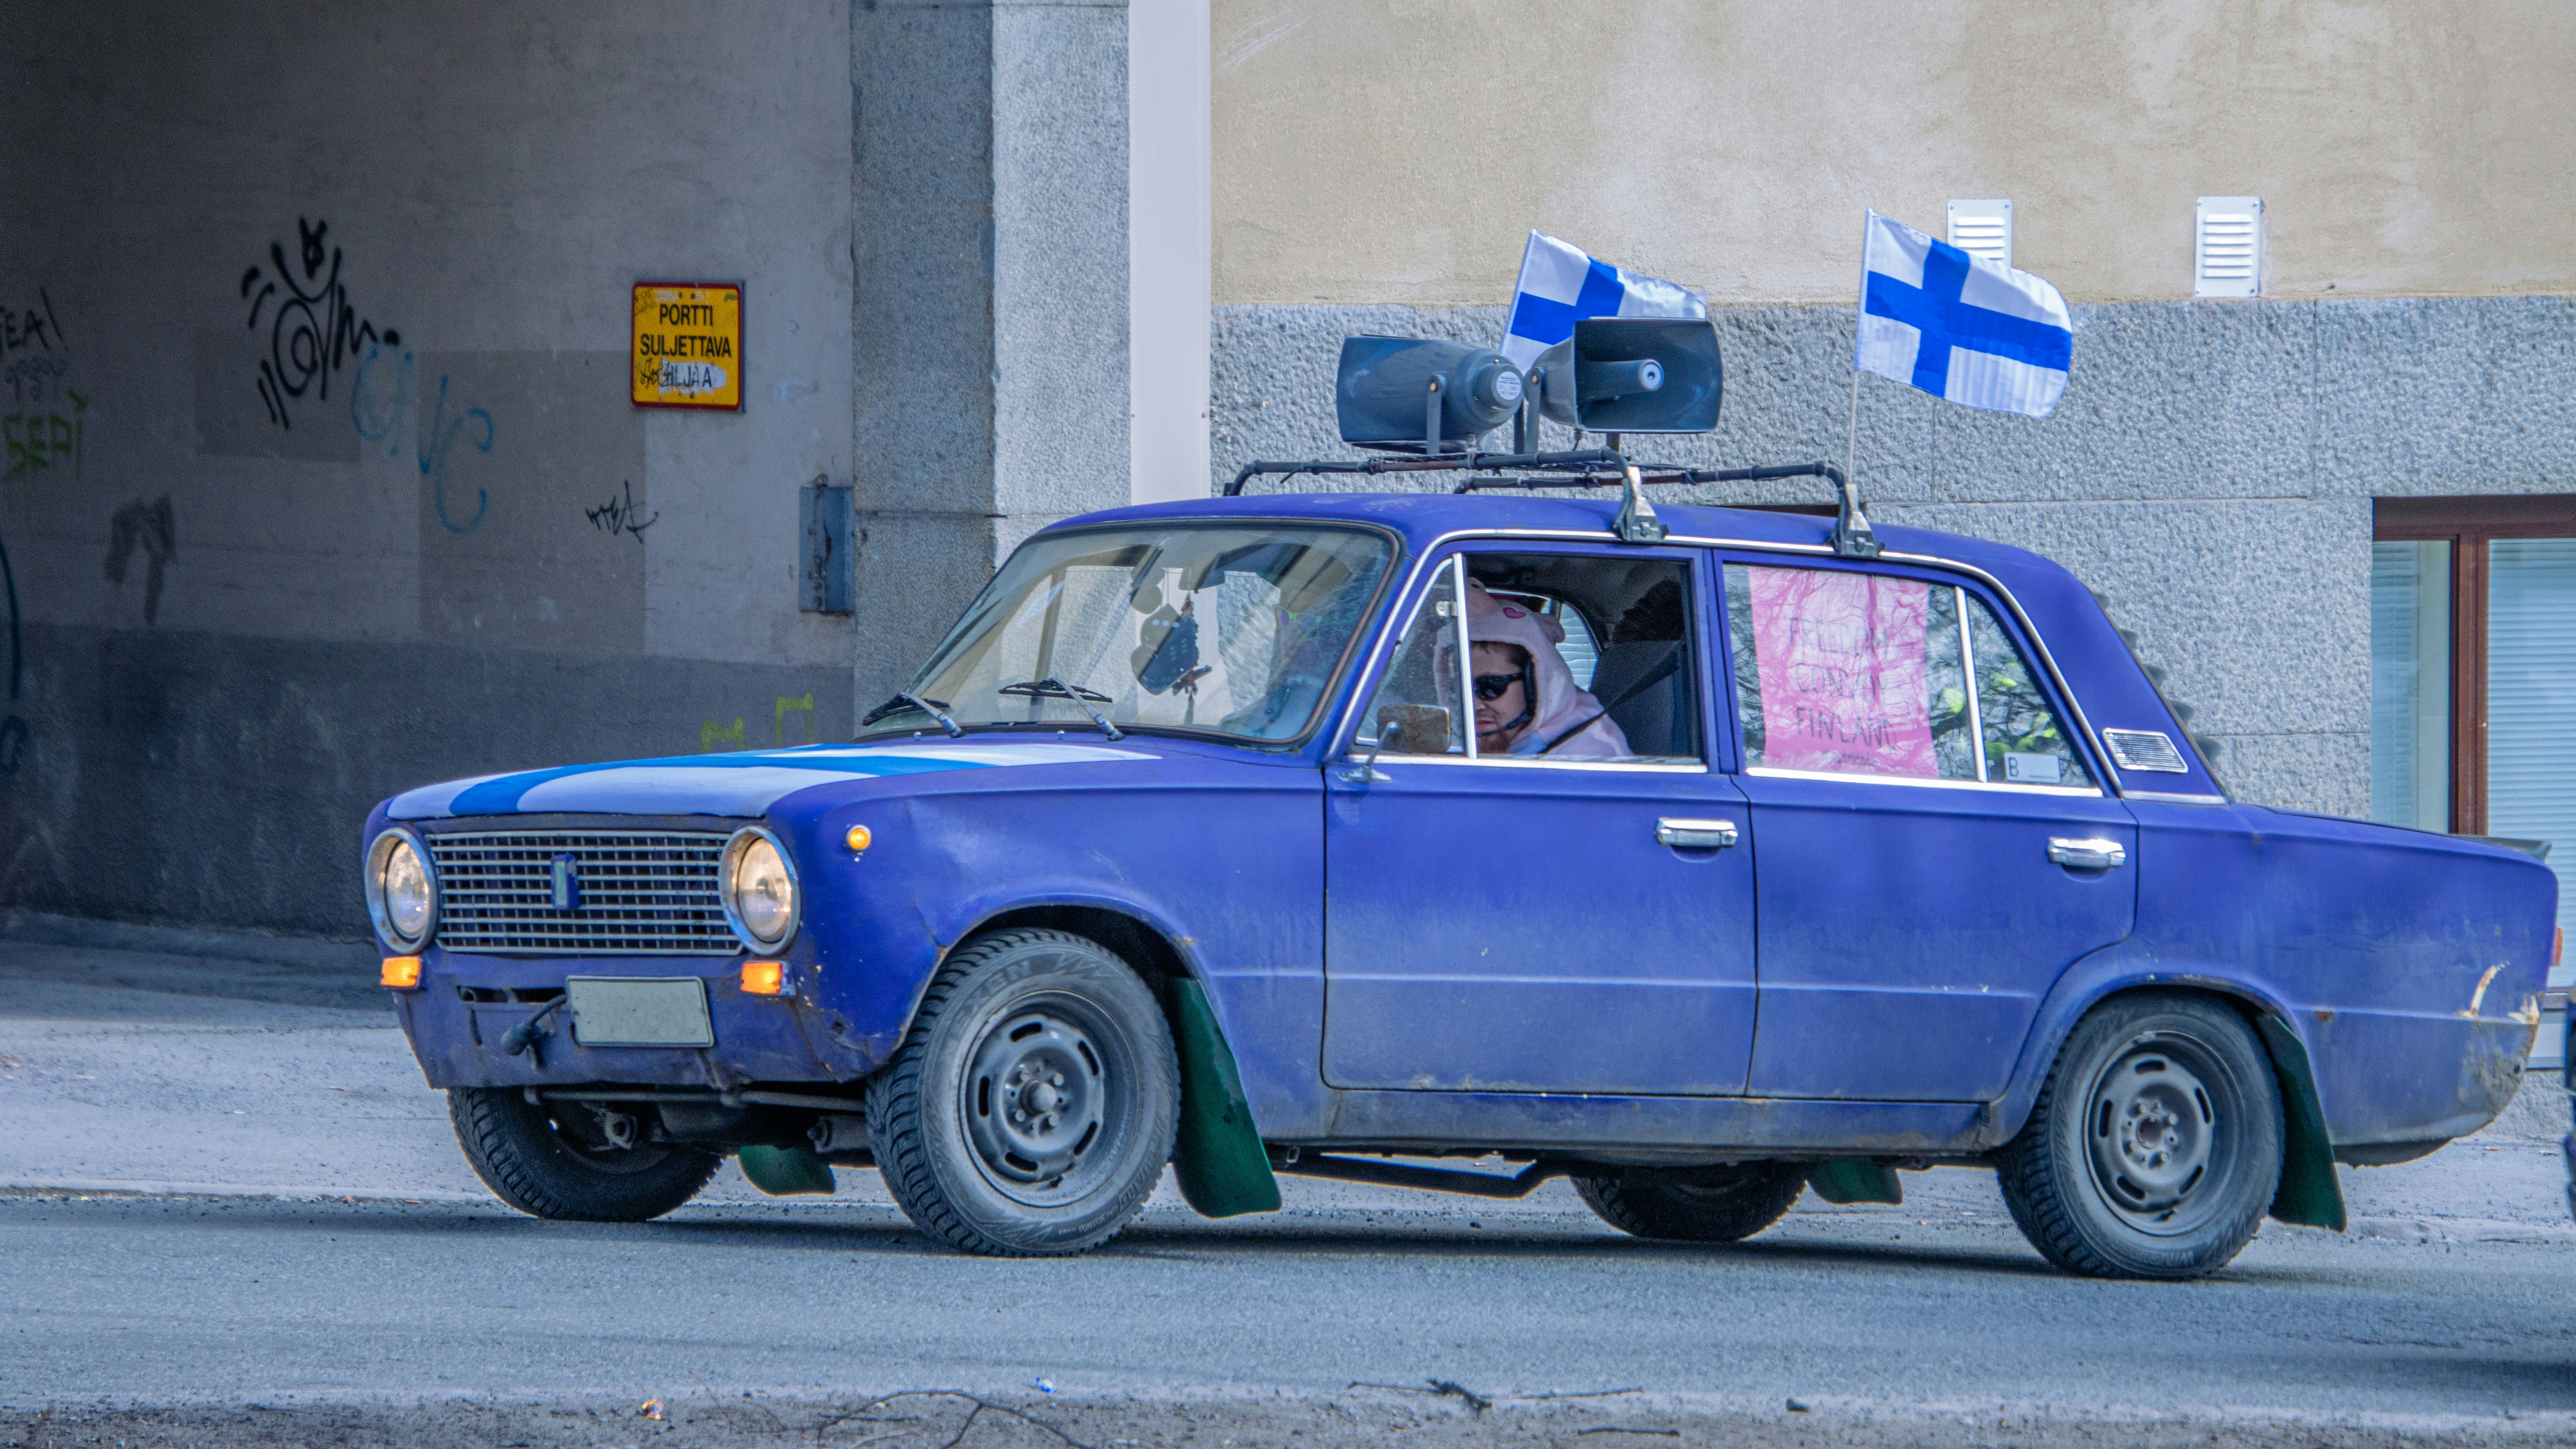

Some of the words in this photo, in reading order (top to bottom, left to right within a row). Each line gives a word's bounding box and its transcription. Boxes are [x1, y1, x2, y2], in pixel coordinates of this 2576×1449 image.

[659, 304, 713, 326] PORTTI
[640, 334, 732, 358] SULJETTAVA
[1789, 616, 1889, 661] FREEDOM
[1795, 706, 1896, 751] FINLAND
